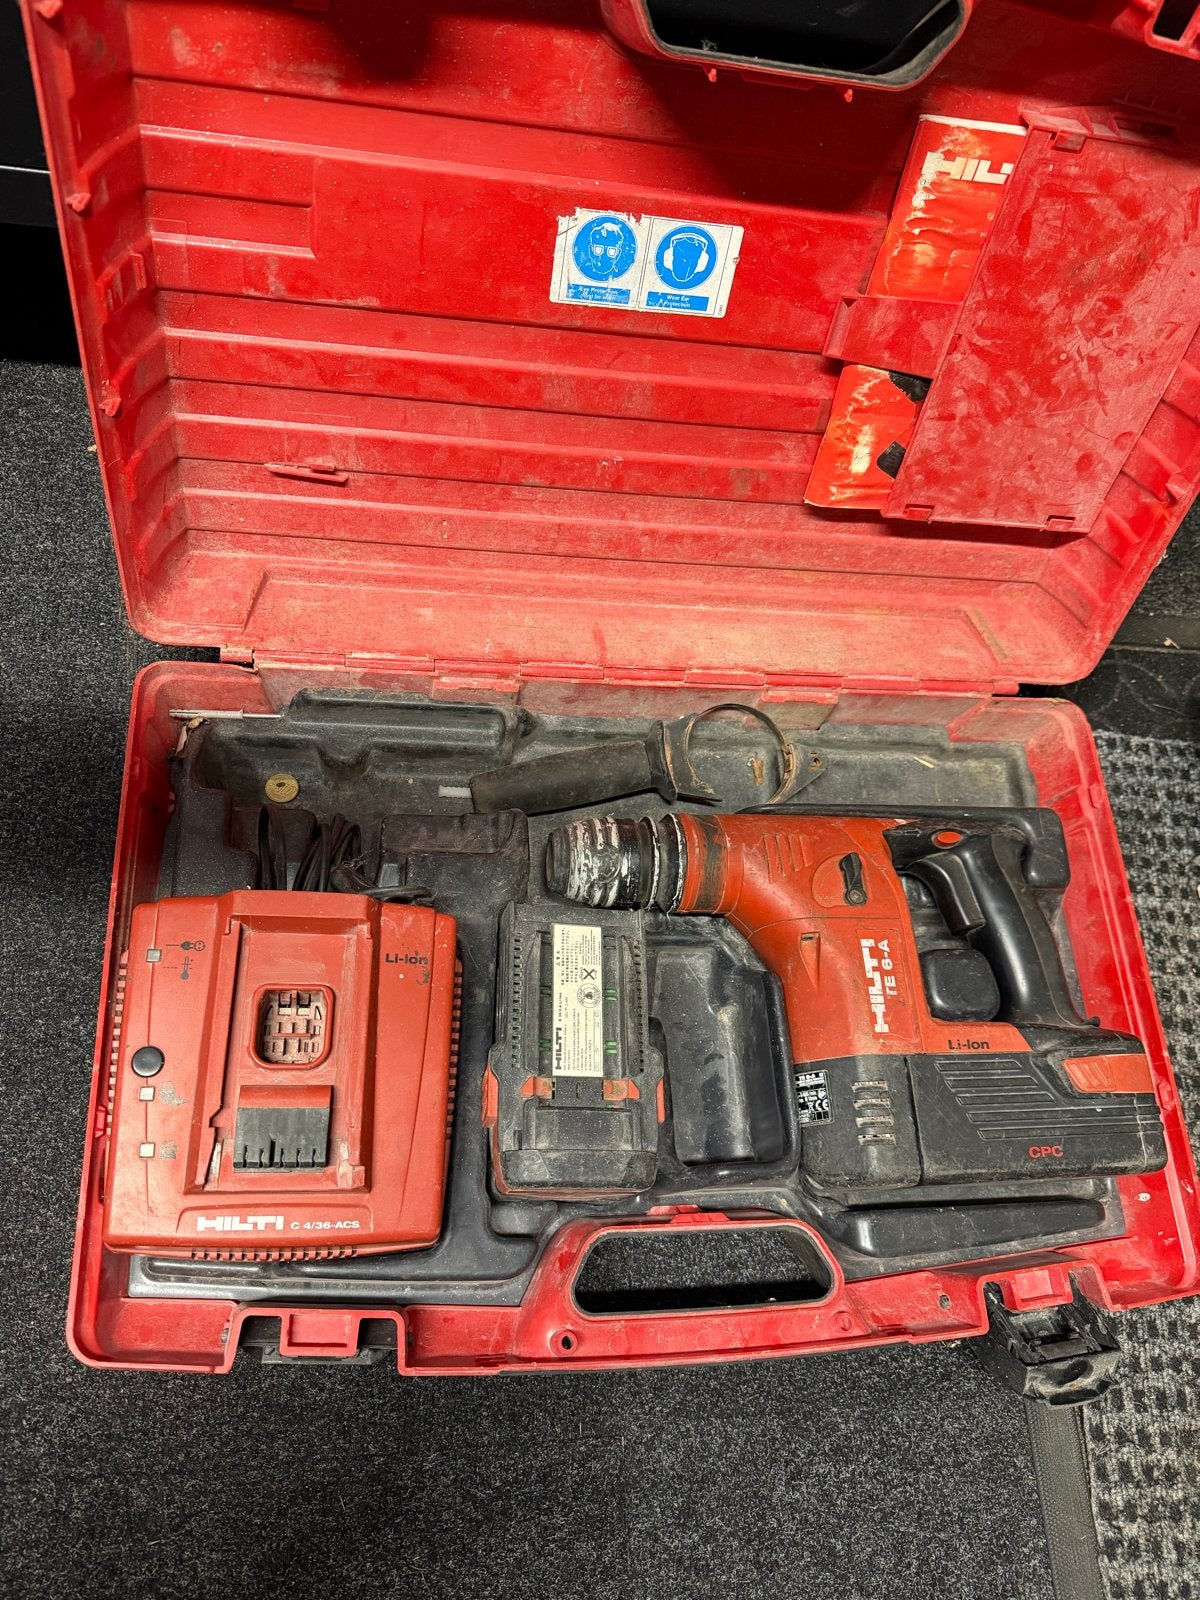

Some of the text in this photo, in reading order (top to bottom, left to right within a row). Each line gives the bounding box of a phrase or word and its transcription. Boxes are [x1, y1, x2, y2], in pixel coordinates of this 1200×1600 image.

[663, 300, 691, 308] Protection
[878, 939, 898, 998] TE 6-A
[860, 938, 889, 1033] HILTI
[948, 1039, 990, 1050] Li-Ion
[1028, 1145, 1064, 1158] CPC
[196, 1216, 361, 1231] HILTI C 4/36-ACS
